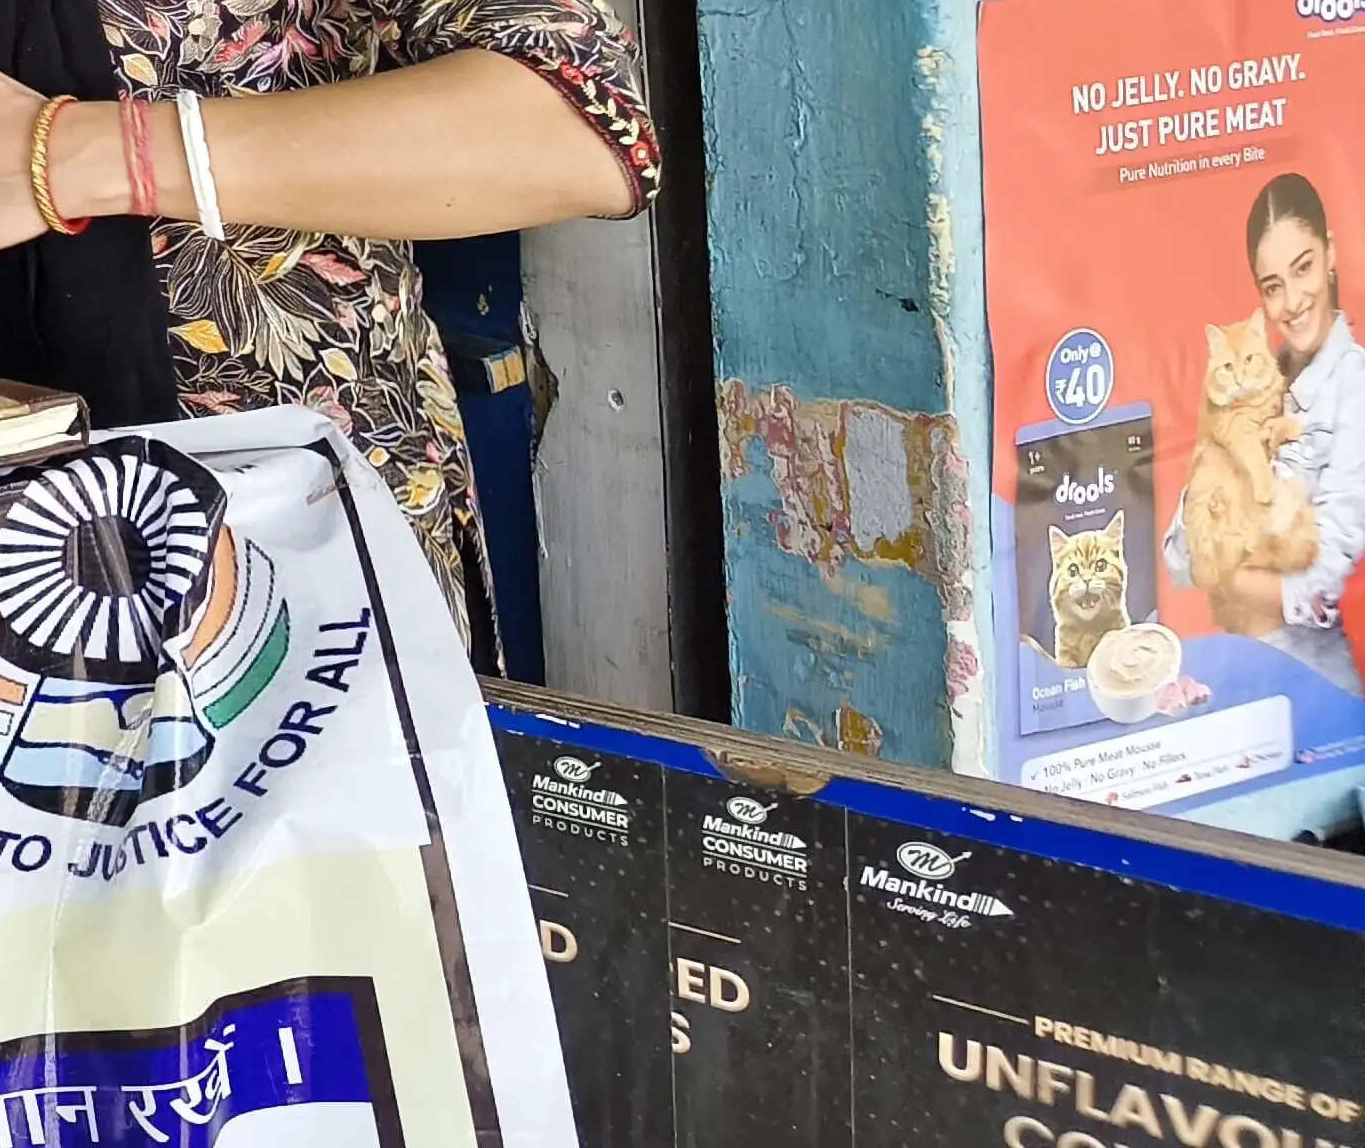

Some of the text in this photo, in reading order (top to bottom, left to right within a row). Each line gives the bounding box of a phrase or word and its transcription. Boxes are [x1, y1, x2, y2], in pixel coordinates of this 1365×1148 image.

[1072, 53, 1307, 115] NO JELLY. NO GRAVY.
[1095, 98, 1287, 155] JUST PURE MEAT
[1119, 146, 1267, 184] Pure Nutrition in every Bite
[1055, 364, 1106, 407] ₹40
[1056, 467, 1114, 505] drools
[234, 700, 339, 798] FOR
[306, 607, 371, 693] ALL
[1032, 677, 1086, 701] Ocean Fish
[1043, 760, 1071, 778] 100%
[532, 775, 605, 803] Mankind
[532, 795, 629, 829] CONSUMER
[533, 816, 629, 847] PRODUCTS
[702, 816, 782, 847] Mankind
[702, 836, 807, 873] CONSUMER
[703, 857, 807, 891] PRODUCTS
[860, 866, 977, 913] Mankind
[1034, 1015, 1362, 1124] PREMIUM RANGE OF
